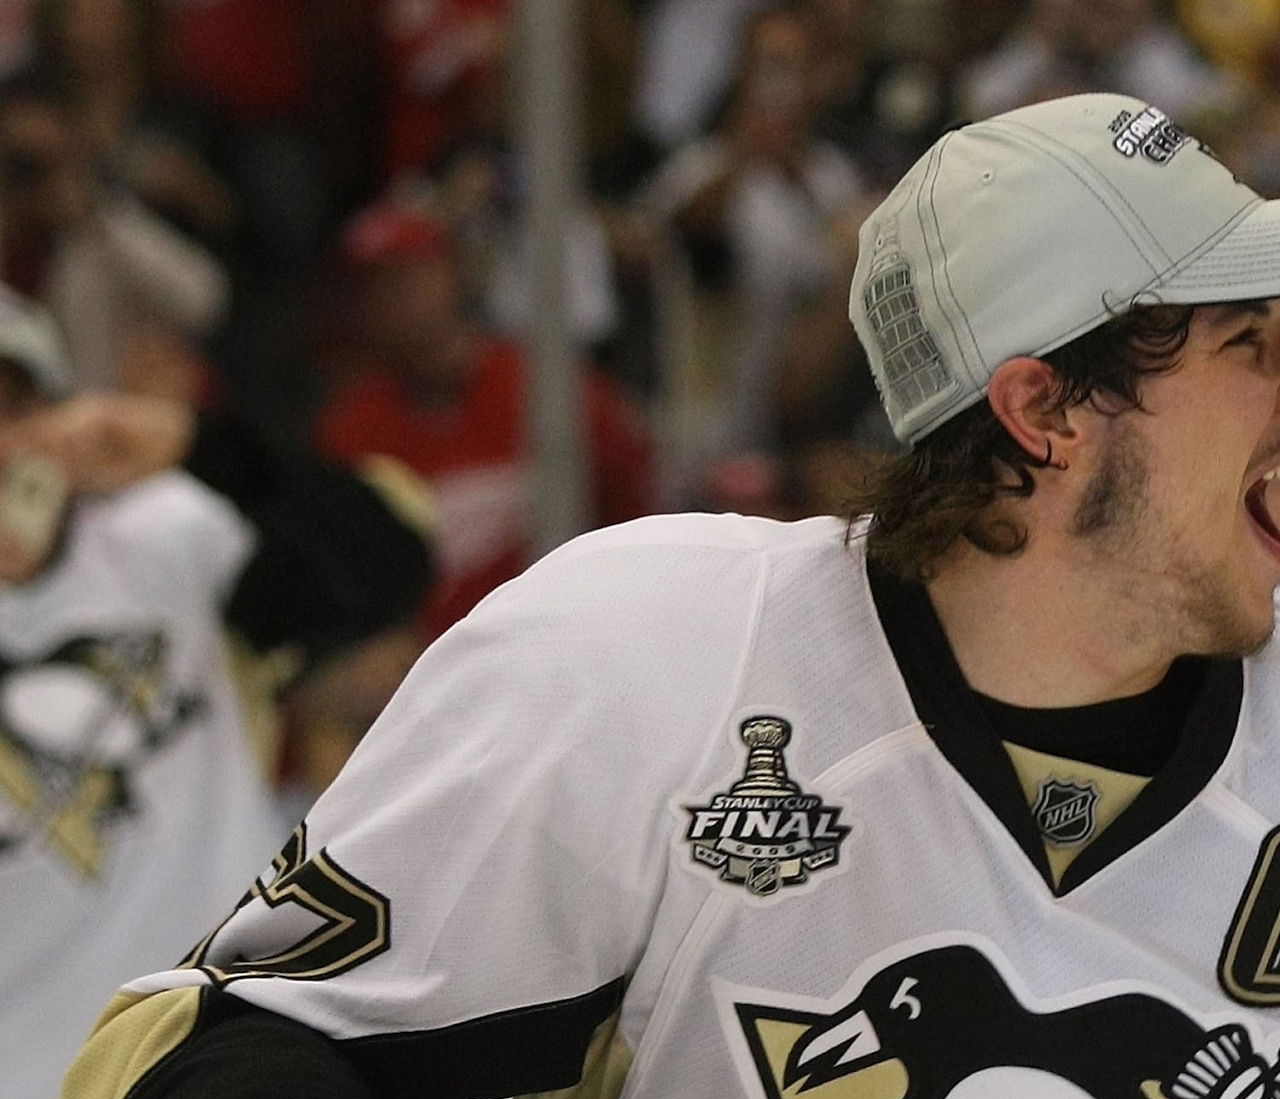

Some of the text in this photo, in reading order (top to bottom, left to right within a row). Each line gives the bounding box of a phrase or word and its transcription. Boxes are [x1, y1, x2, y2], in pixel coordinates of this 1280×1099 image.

[712, 796, 820, 809] STANLEY CUP
[1043, 796, 1089, 829] NHL
[690, 810, 841, 838] FINAL
